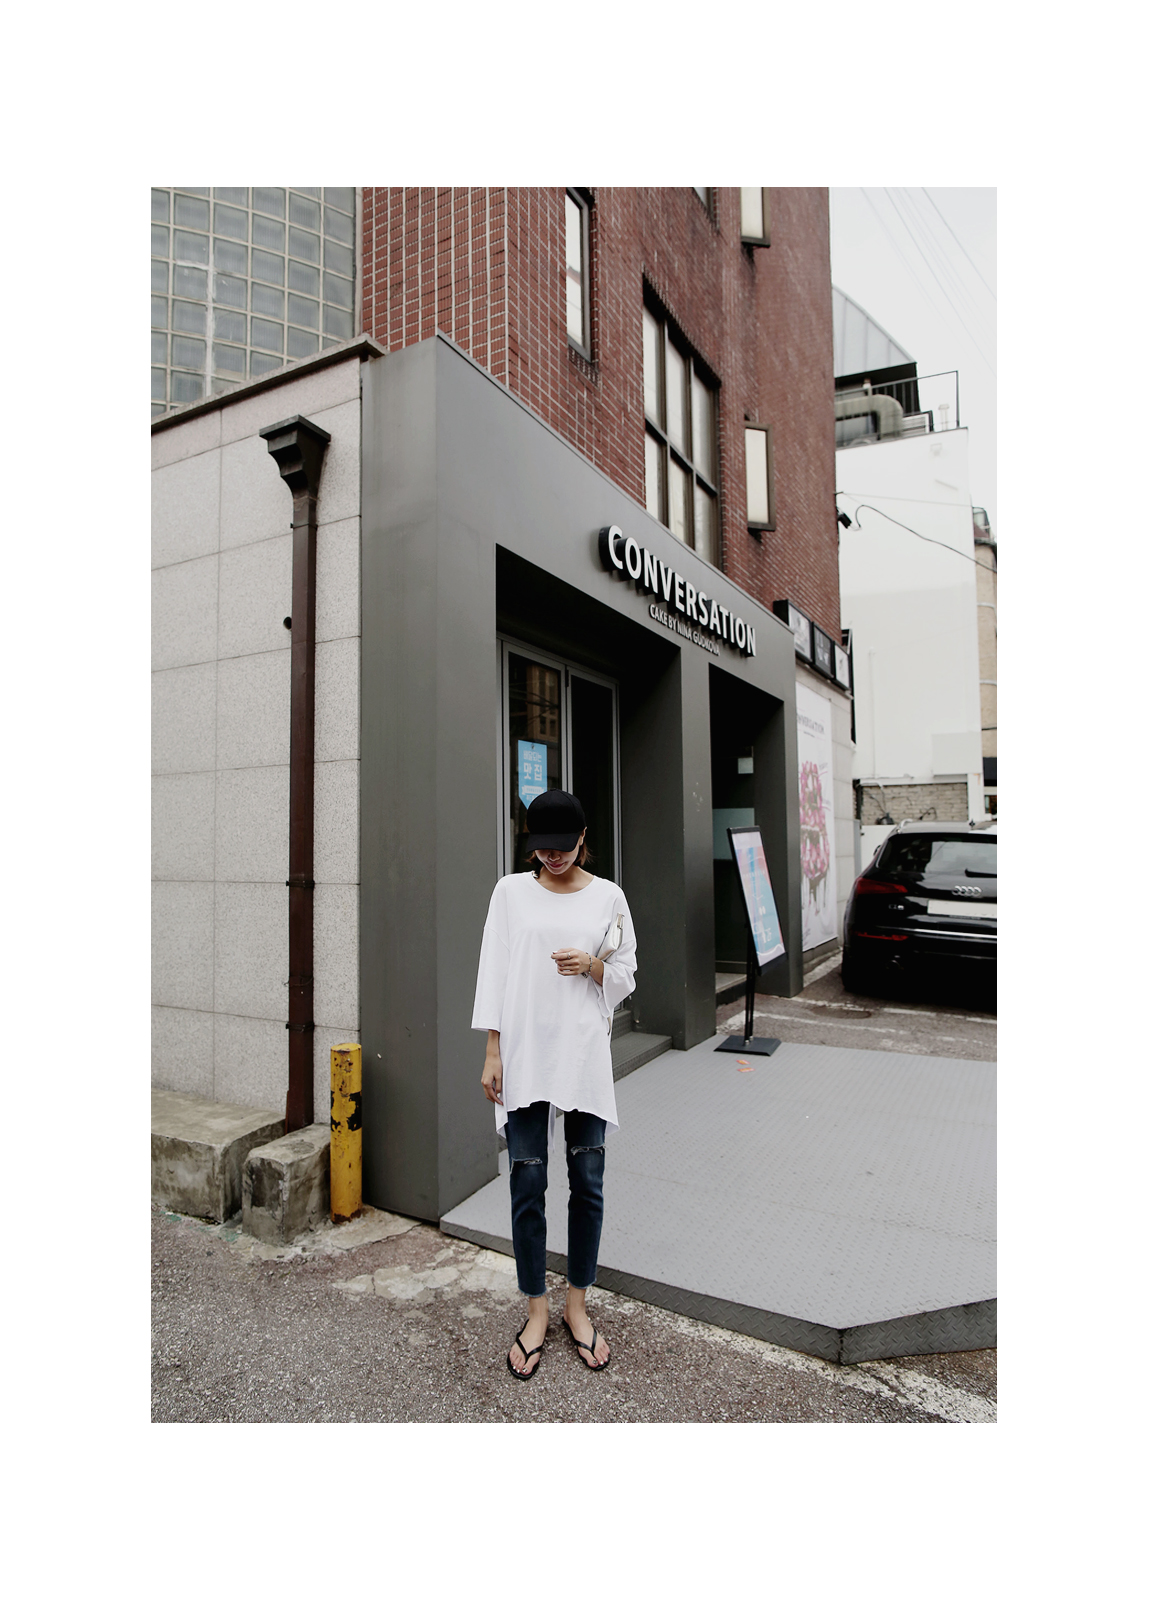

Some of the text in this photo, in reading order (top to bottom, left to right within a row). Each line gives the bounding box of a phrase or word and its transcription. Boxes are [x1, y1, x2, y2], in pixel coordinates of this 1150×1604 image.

[607, 525, 756, 656] CONVERSATION
[649, 604, 667, 626] CAKE
[668, 614, 676, 631] BY
[677, 620, 692, 640] NINA
